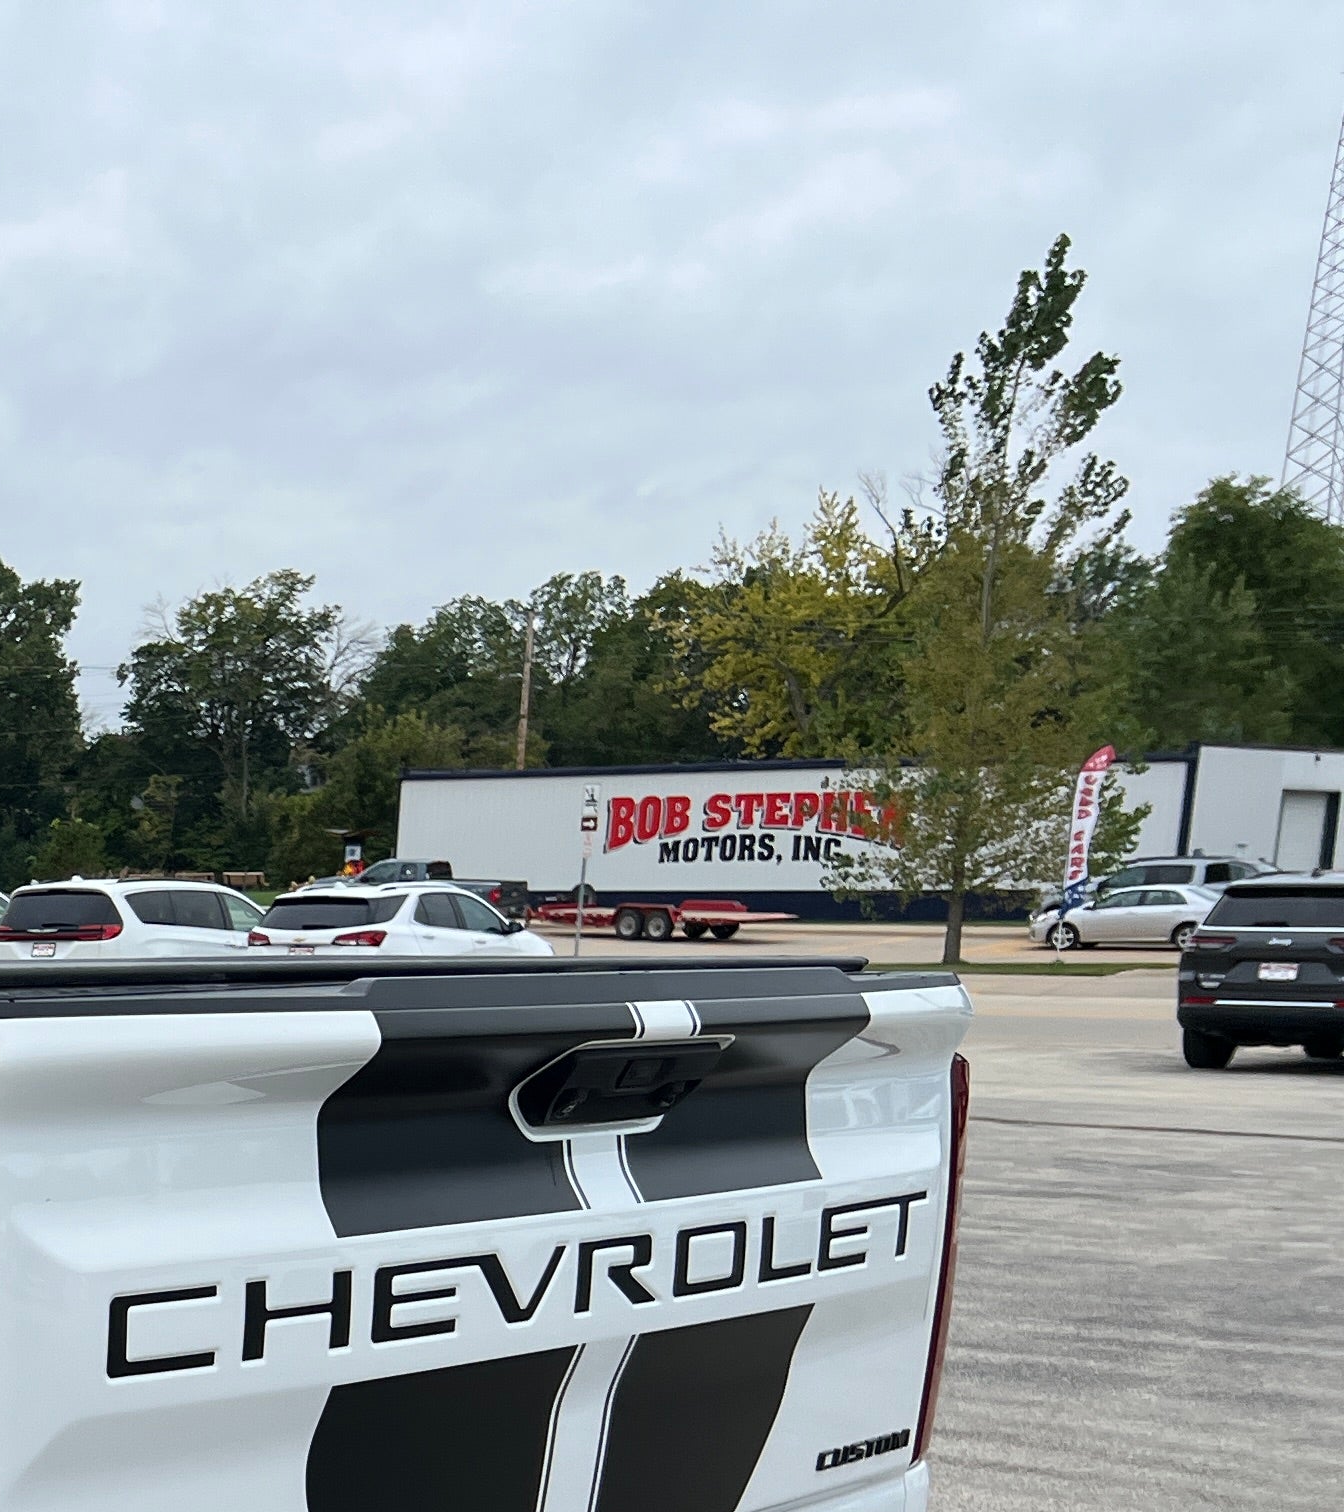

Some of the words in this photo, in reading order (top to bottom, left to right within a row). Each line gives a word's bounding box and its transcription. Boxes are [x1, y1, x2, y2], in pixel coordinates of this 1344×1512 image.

[604, 795, 692, 854] BOB
[659, 833, 782, 864] MOTORS,
[106, 1189, 929, 1380] CHEVROLET
[815, 1428, 911, 1471] CUSTOM
